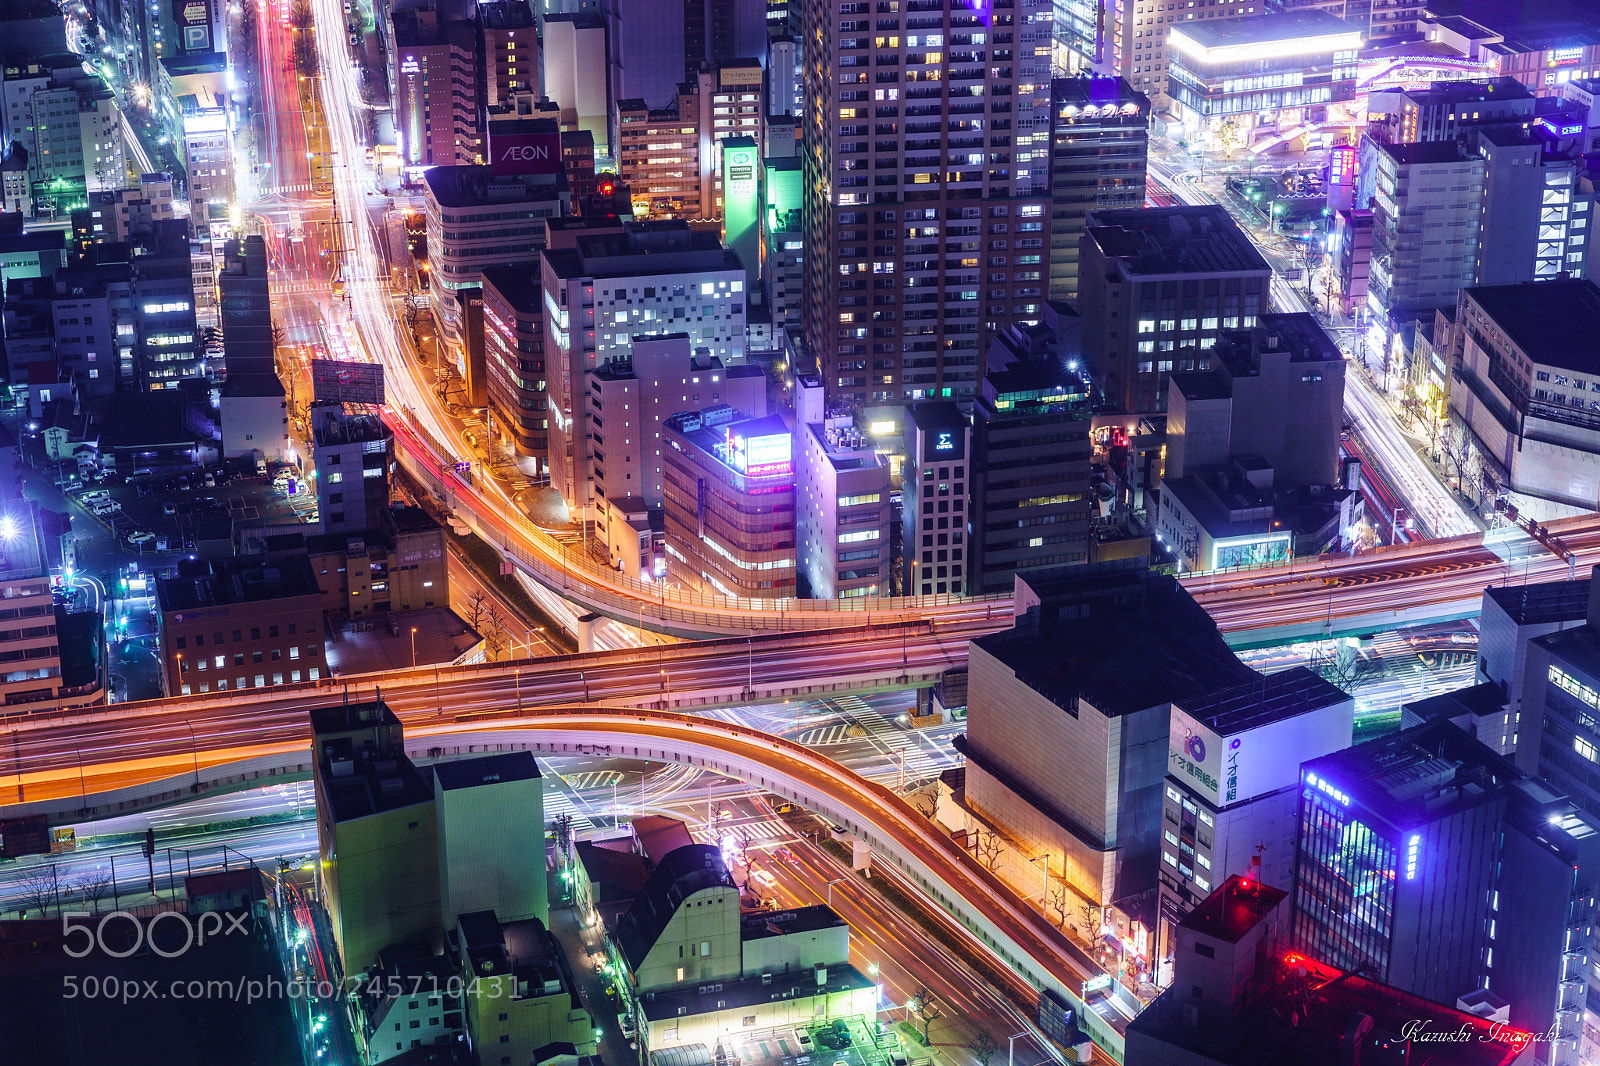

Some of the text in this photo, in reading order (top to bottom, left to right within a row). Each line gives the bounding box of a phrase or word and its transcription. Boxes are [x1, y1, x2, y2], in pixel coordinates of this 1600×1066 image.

[188, 28, 204, 46] P
[1170, 753, 1218, 792] イオ信用組合
[1226, 752, 1239, 802] イオ信組
